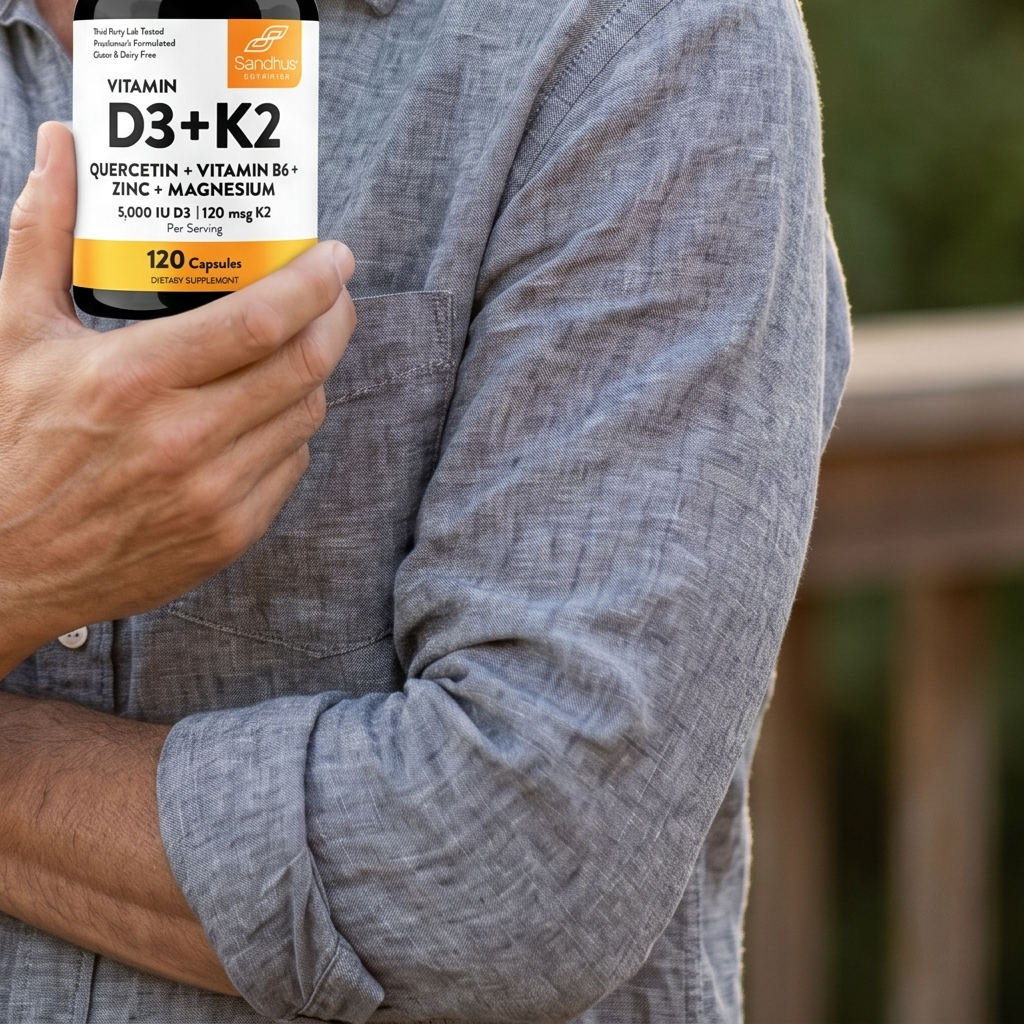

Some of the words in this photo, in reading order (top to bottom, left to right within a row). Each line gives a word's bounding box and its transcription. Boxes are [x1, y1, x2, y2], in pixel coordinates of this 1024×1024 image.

[113, 50, 119, 59] &
[140, 50, 157, 59] Free
[107, 78, 177, 94] VITAMIN
[90, 162, 179, 180] QUERCETIN
[183, 166, 193, 176] +
[196, 163, 269, 178] VITAMIN
[112, 181, 150, 196] ZINC
[154, 185, 163, 195] +
[168, 181, 276, 197] MAGNESIUM
[118, 206, 152, 221] 5,000
[155, 207, 171, 219] IU
[173, 207, 191, 219] D3
[201, 206, 225, 219] 120
[255, 205, 272, 218] K2
[167, 223, 184, 234] Per
[186, 223, 224, 237] Serving
[146, 249, 185, 270] 120
[188, 257, 242, 274] Capsules
